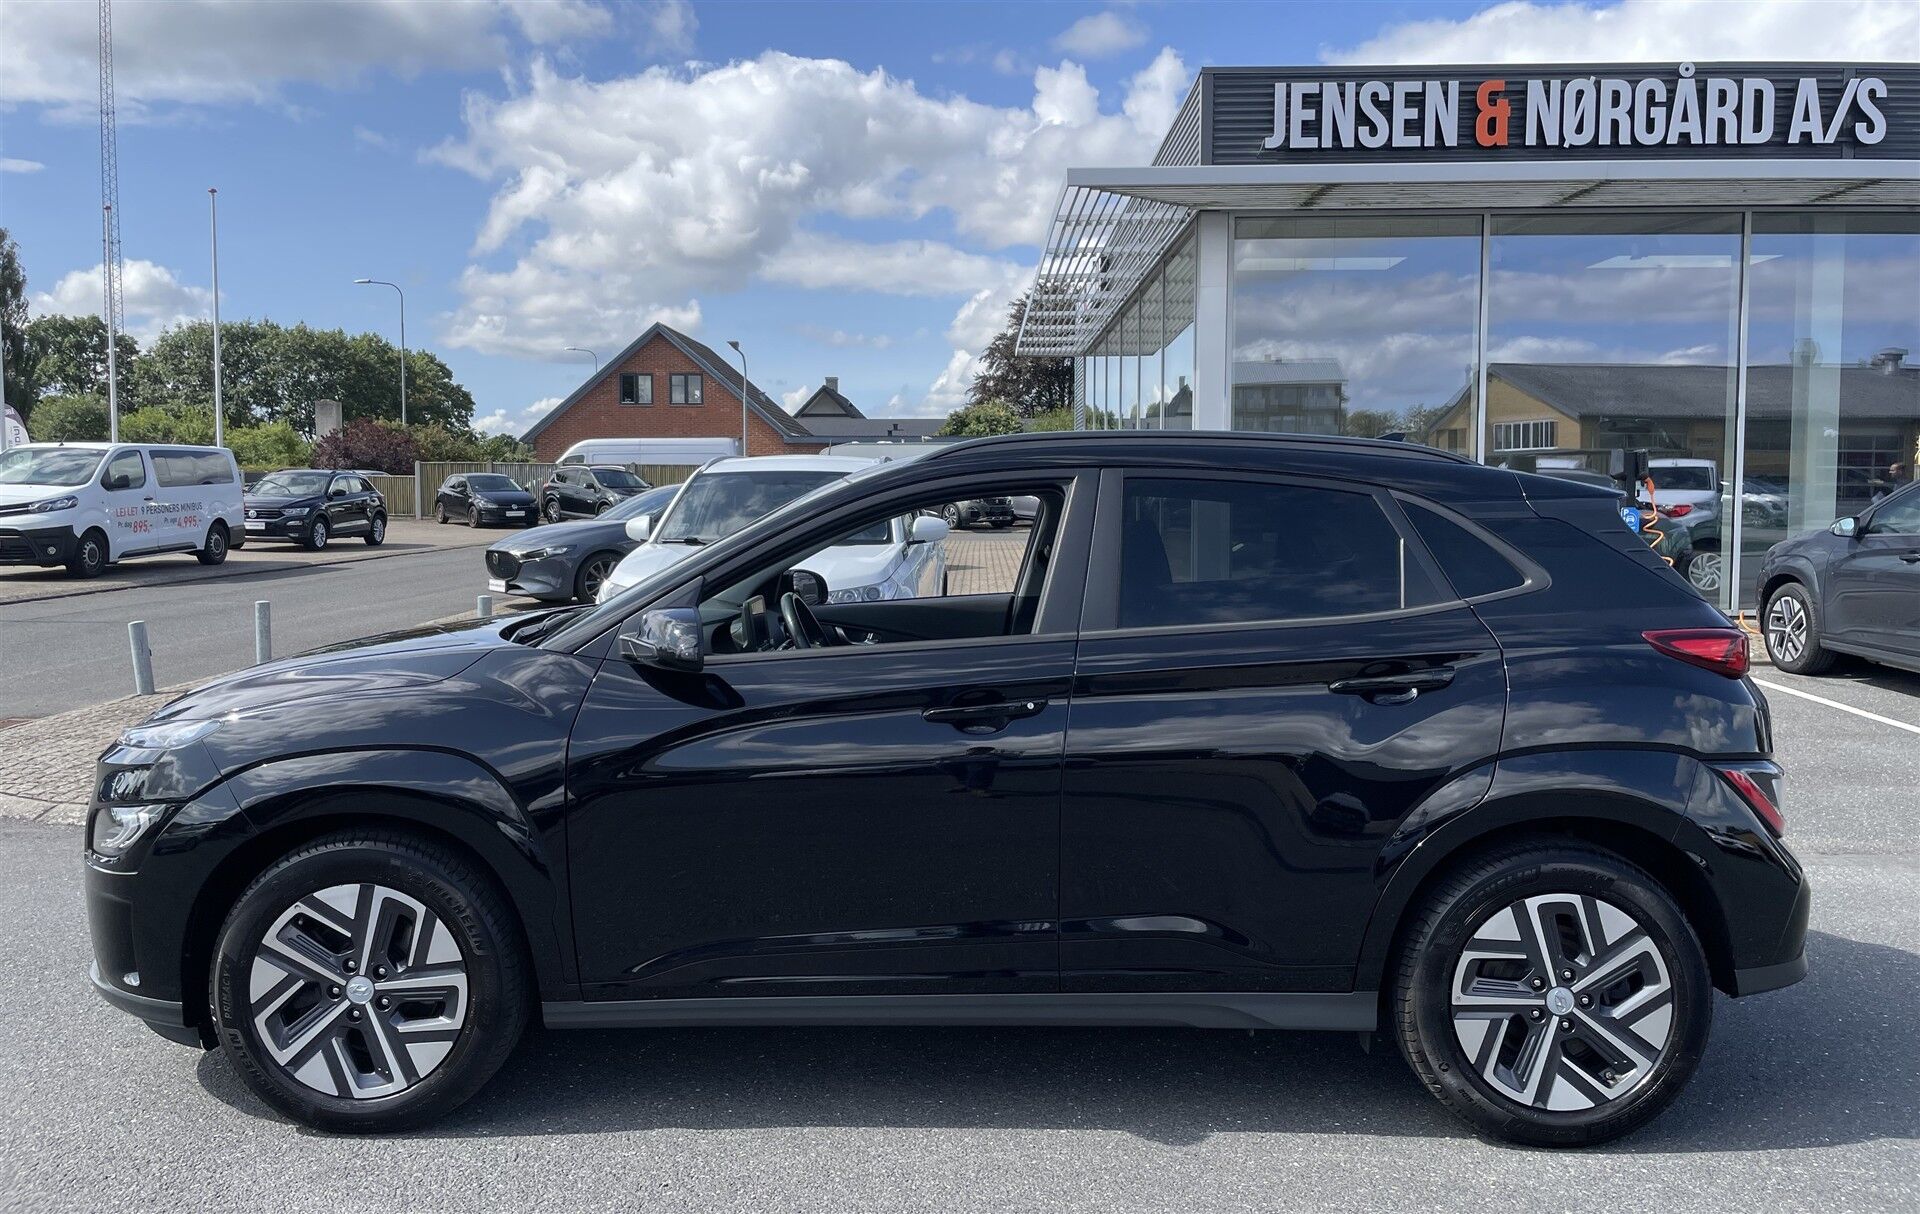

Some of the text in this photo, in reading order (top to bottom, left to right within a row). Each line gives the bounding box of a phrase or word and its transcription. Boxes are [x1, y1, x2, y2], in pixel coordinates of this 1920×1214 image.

[1264, 62, 1888, 149] JENSEN & NØRGÅRD A/S
[127, 507, 138, 516] LET
[140, 506, 145, 515] 9
[146, 503, 180, 515] PERSONERS
[180, 501, 203, 513] MINIBUS
[133, 520, 153, 534] 895,-
